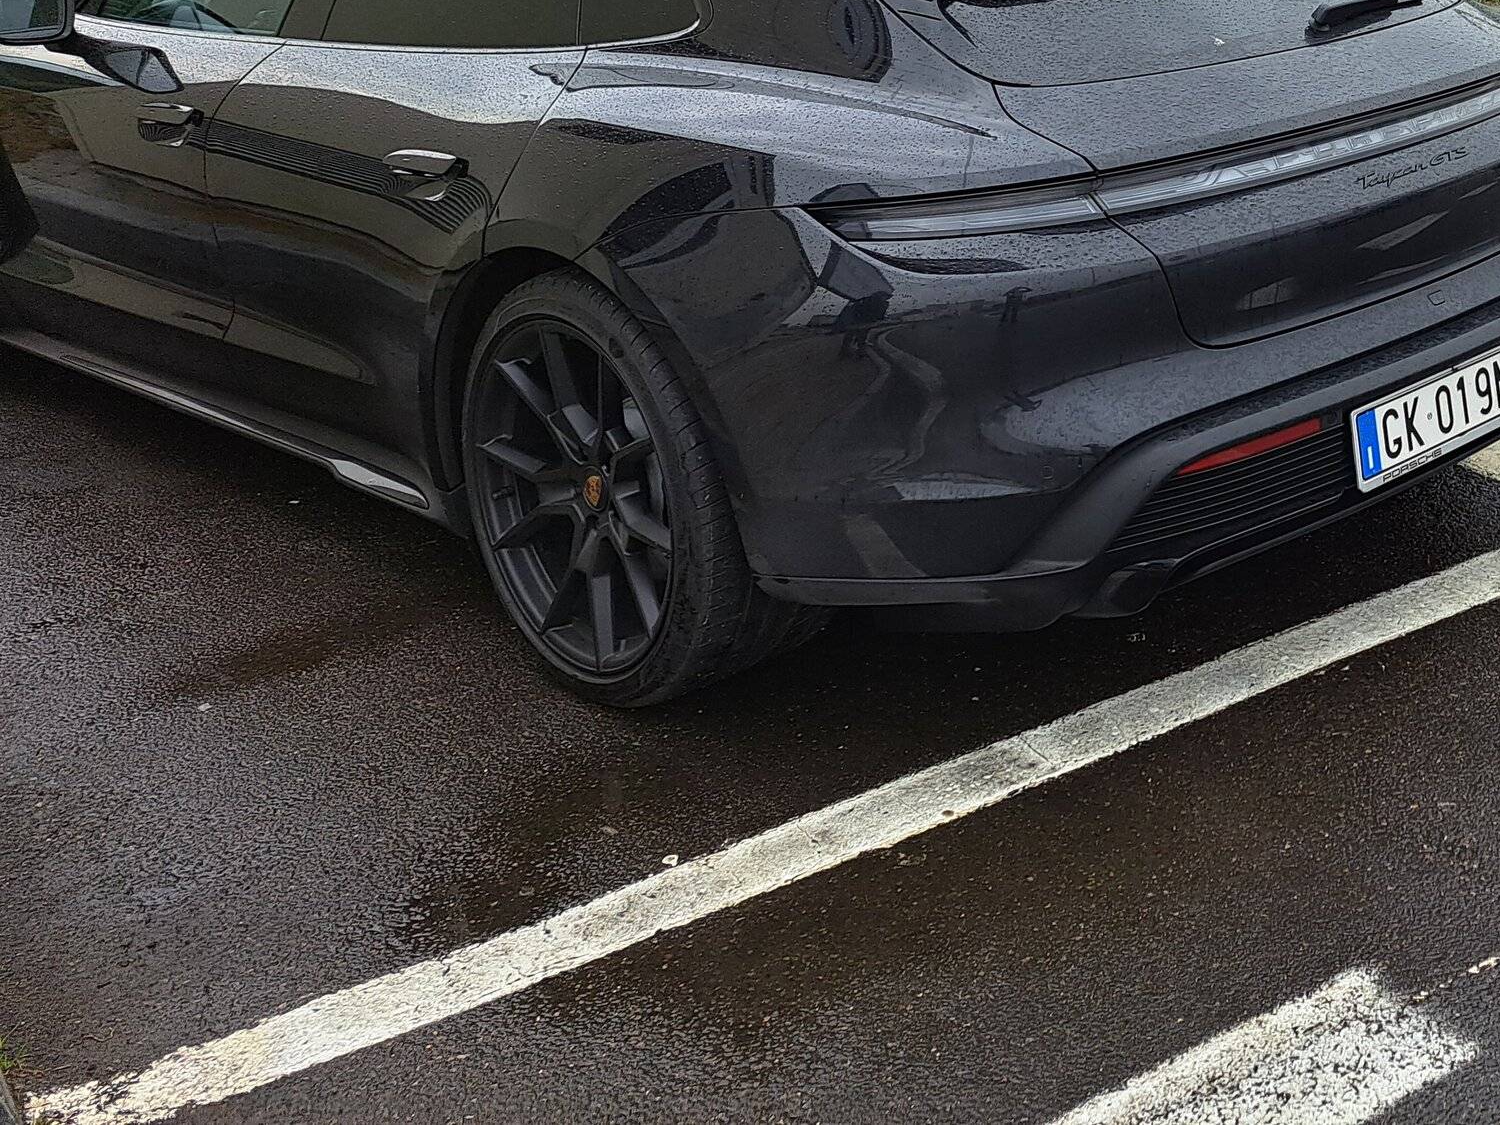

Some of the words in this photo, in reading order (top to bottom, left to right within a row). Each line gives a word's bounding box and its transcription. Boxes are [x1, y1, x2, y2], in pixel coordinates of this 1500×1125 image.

[1354, 164, 1428, 190] Taycan
[1430, 146, 1468, 167] GTS
[1382, 396, 1425, 459] GK
[1382, 447, 1442, 482] PORSCHE
